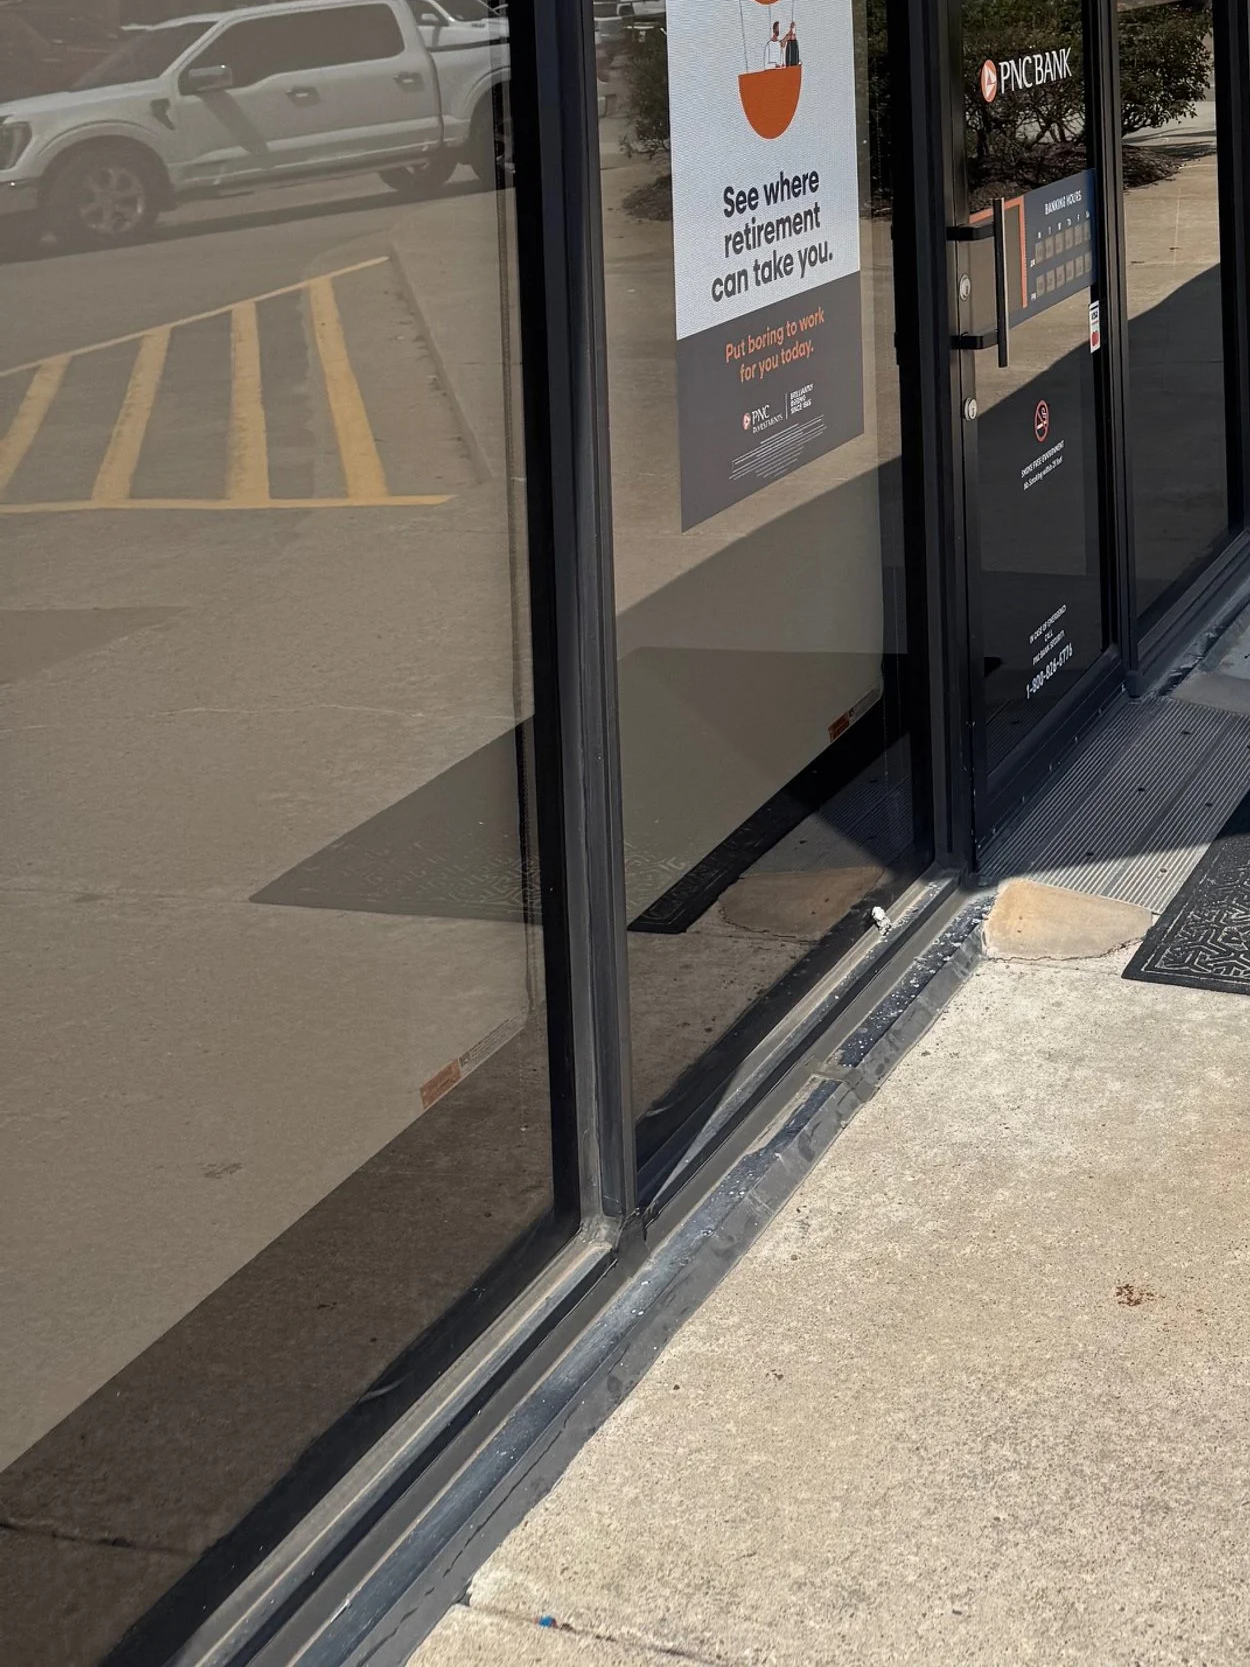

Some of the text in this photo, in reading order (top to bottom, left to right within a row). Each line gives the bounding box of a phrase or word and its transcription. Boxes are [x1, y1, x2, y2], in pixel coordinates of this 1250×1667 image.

[723, 170, 820, 218] See where
[1044, 190, 1082, 216] BANKING HOURS
[724, 201, 821, 258] retirement
[711, 240, 833, 303] can take you.
[725, 306, 825, 363] Put boring to work
[740, 339, 814, 383] for you today.
[751, 404, 770, 425] PNC
